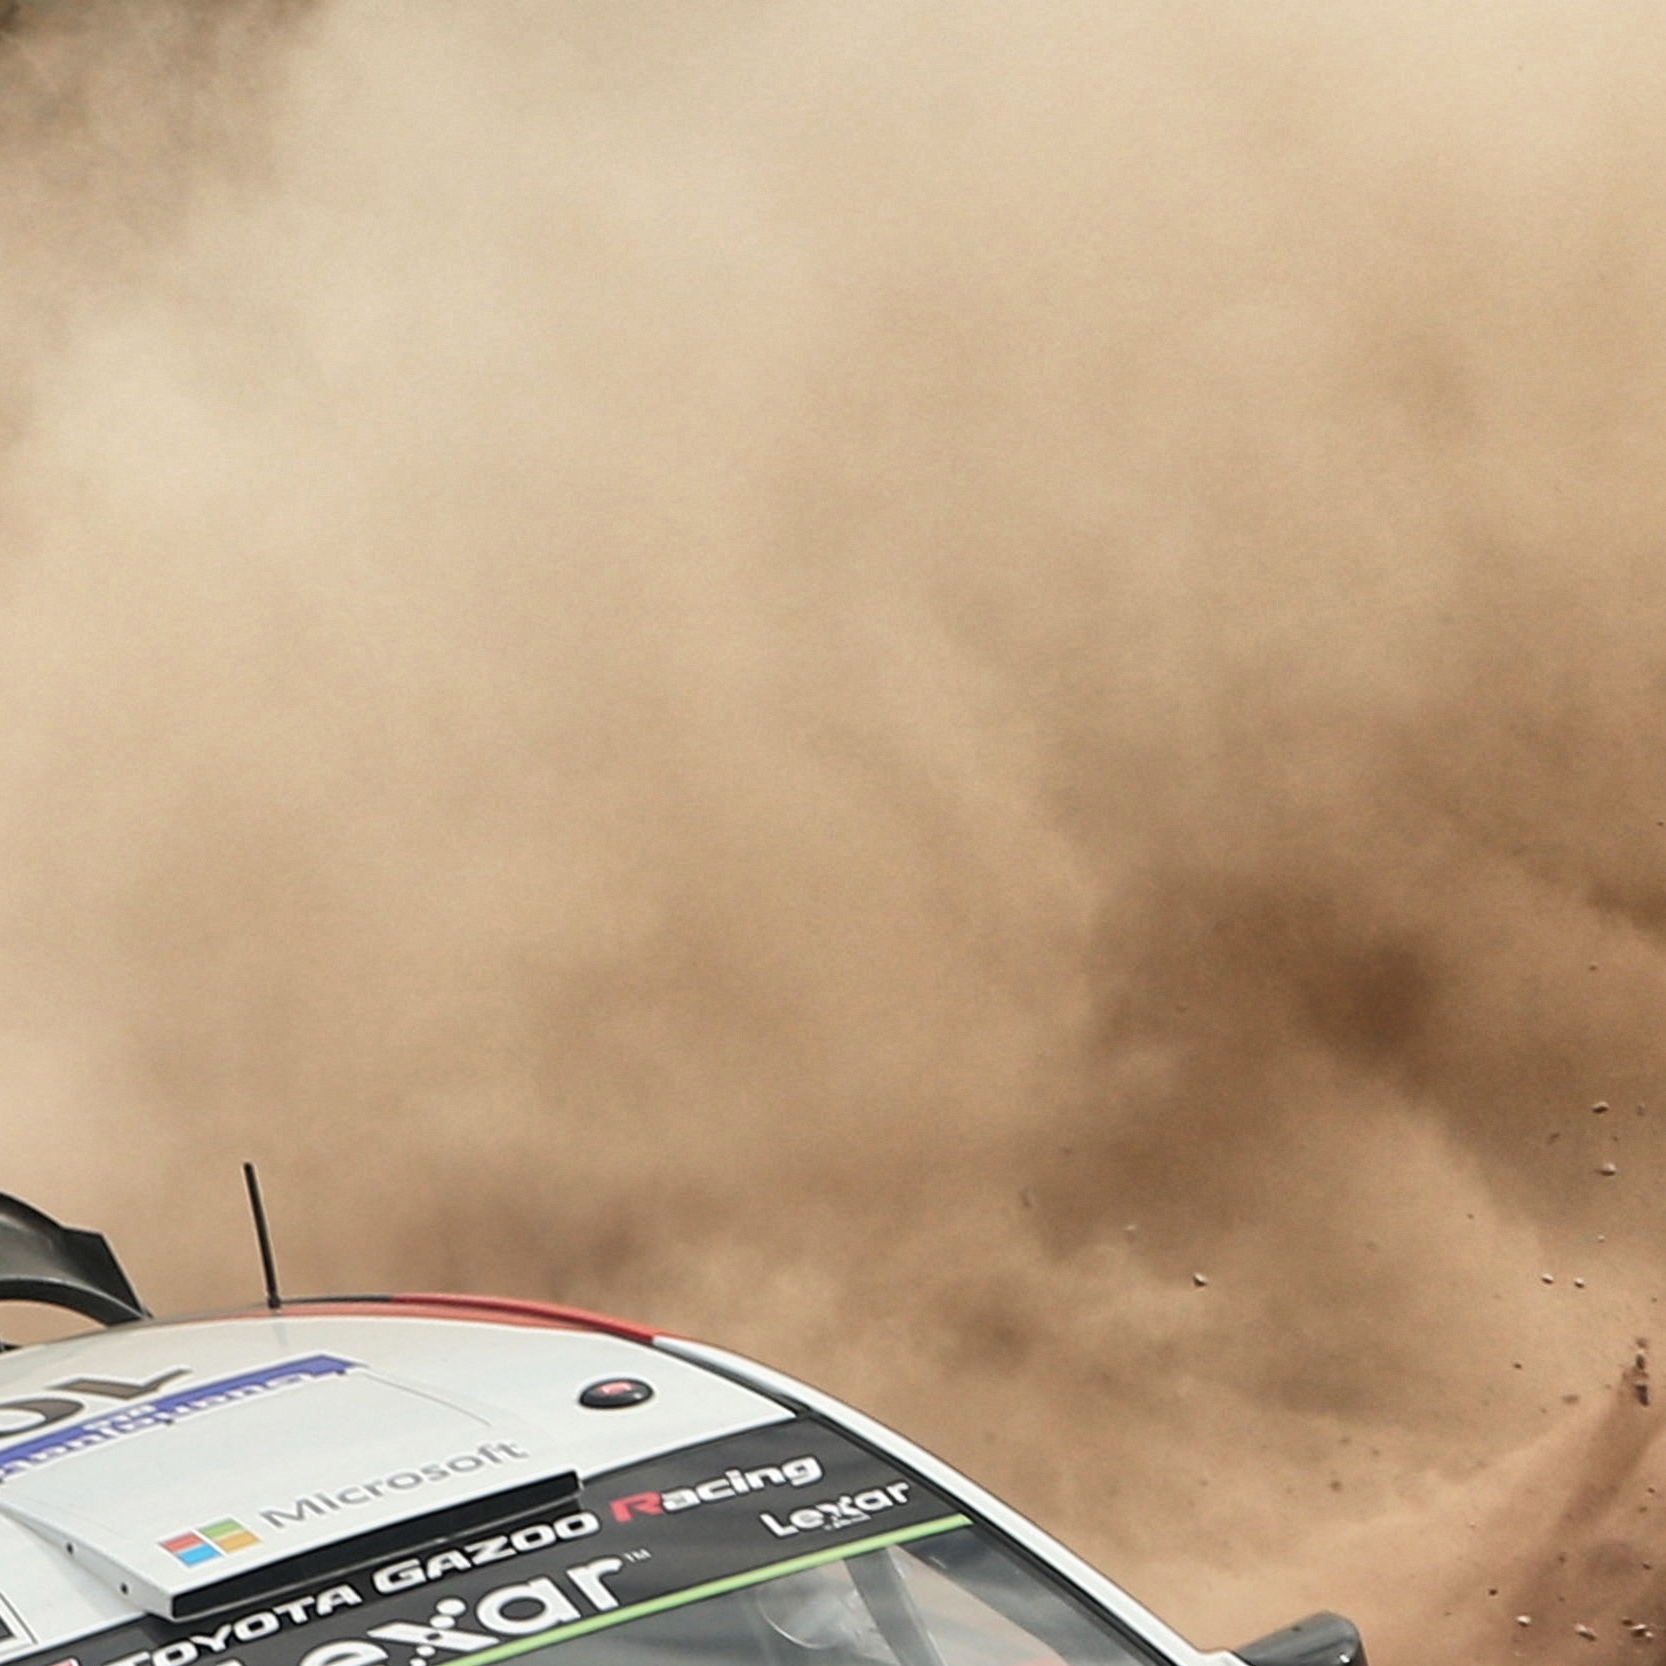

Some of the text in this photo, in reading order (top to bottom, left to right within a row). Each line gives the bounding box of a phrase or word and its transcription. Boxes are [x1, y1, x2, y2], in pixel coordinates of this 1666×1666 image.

[260, 1438, 529, 1531] Microsoft
[371, 1510, 601, 1597] GAZOO
[611, 1455, 824, 1524] Racing
[760, 1481, 910, 1538] Lexar
